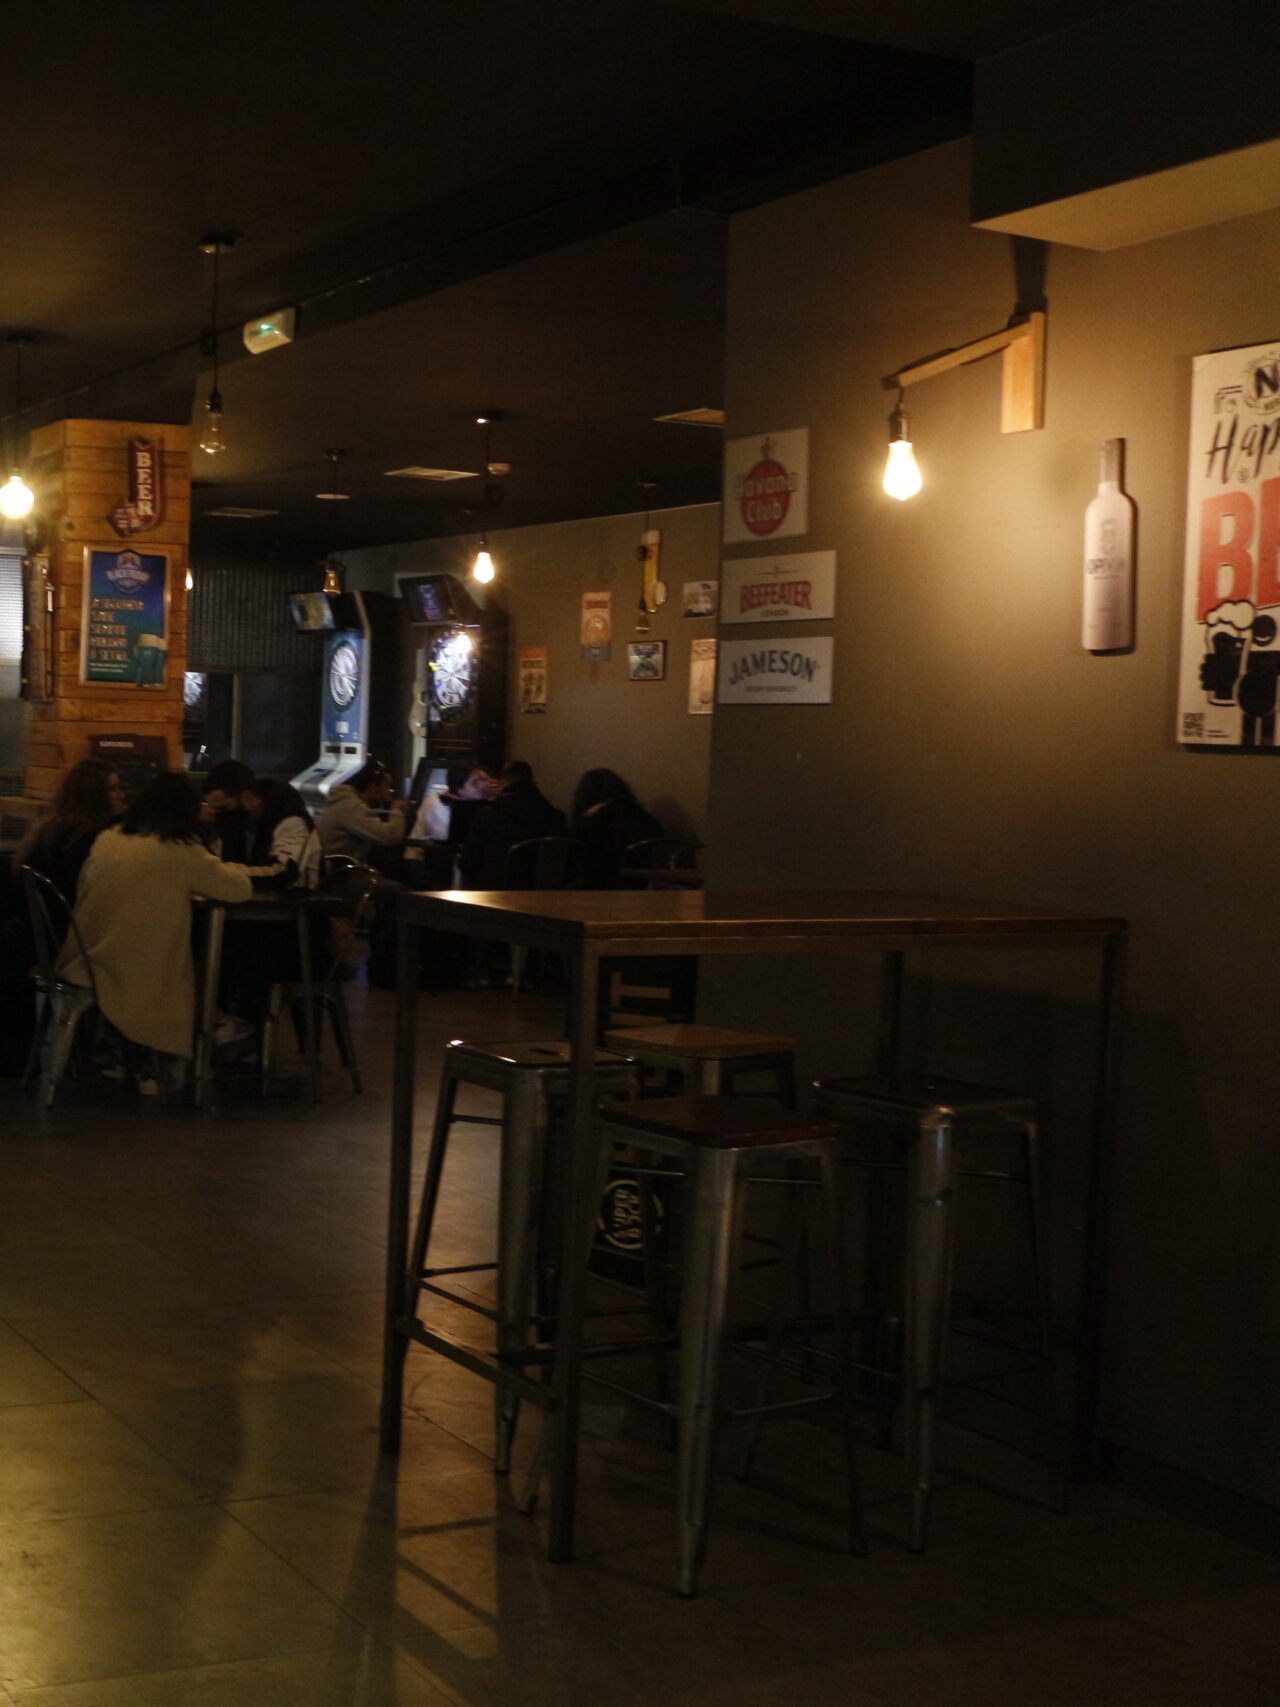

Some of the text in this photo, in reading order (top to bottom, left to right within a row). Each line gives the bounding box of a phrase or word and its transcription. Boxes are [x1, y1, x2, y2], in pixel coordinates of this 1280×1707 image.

[136, 452, 154, 516] BEER
[746, 498, 782, 524] Club
[740, 580, 812, 614] BEEFEATER
[729, 650, 816, 685] JAMESON
